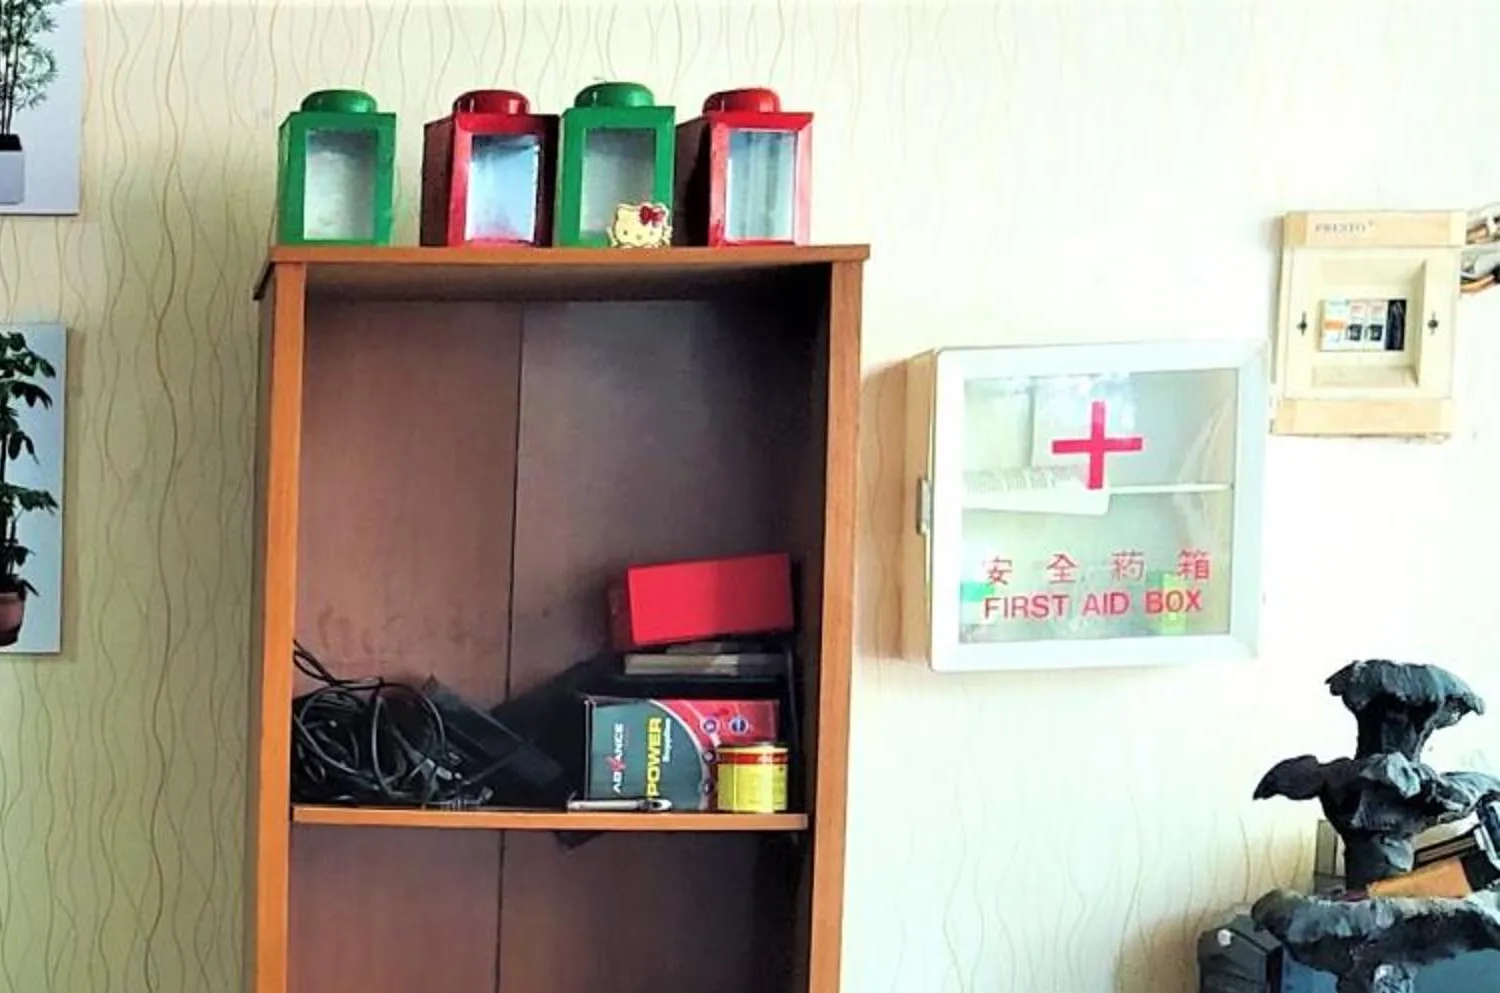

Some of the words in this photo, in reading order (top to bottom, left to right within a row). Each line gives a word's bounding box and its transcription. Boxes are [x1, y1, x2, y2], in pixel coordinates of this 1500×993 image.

[984, 592, 1069, 619] FIRST
[1080, 590, 1131, 617] AID
[1144, 588, 1203, 615] BOX
[647, 718, 662, 797] POWER
